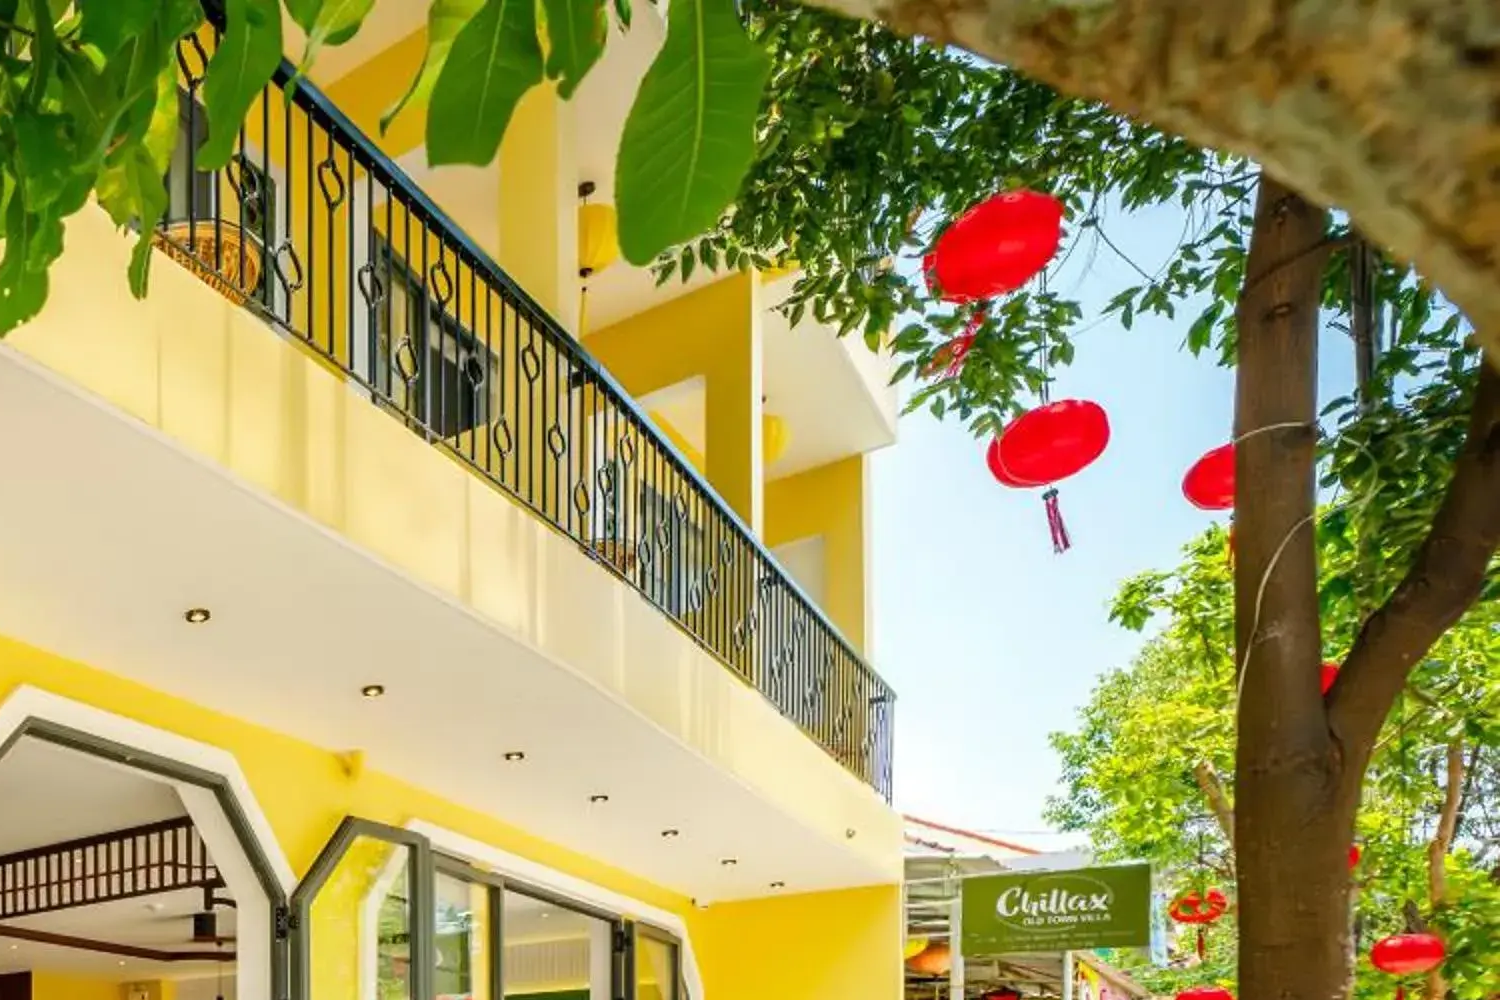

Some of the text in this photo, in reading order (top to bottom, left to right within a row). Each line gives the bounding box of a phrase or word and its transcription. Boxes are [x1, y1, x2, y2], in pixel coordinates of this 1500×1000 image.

[996, 886, 1109, 917] Chillax
[1023, 912, 1111, 927] OLD TOWN VILLA
